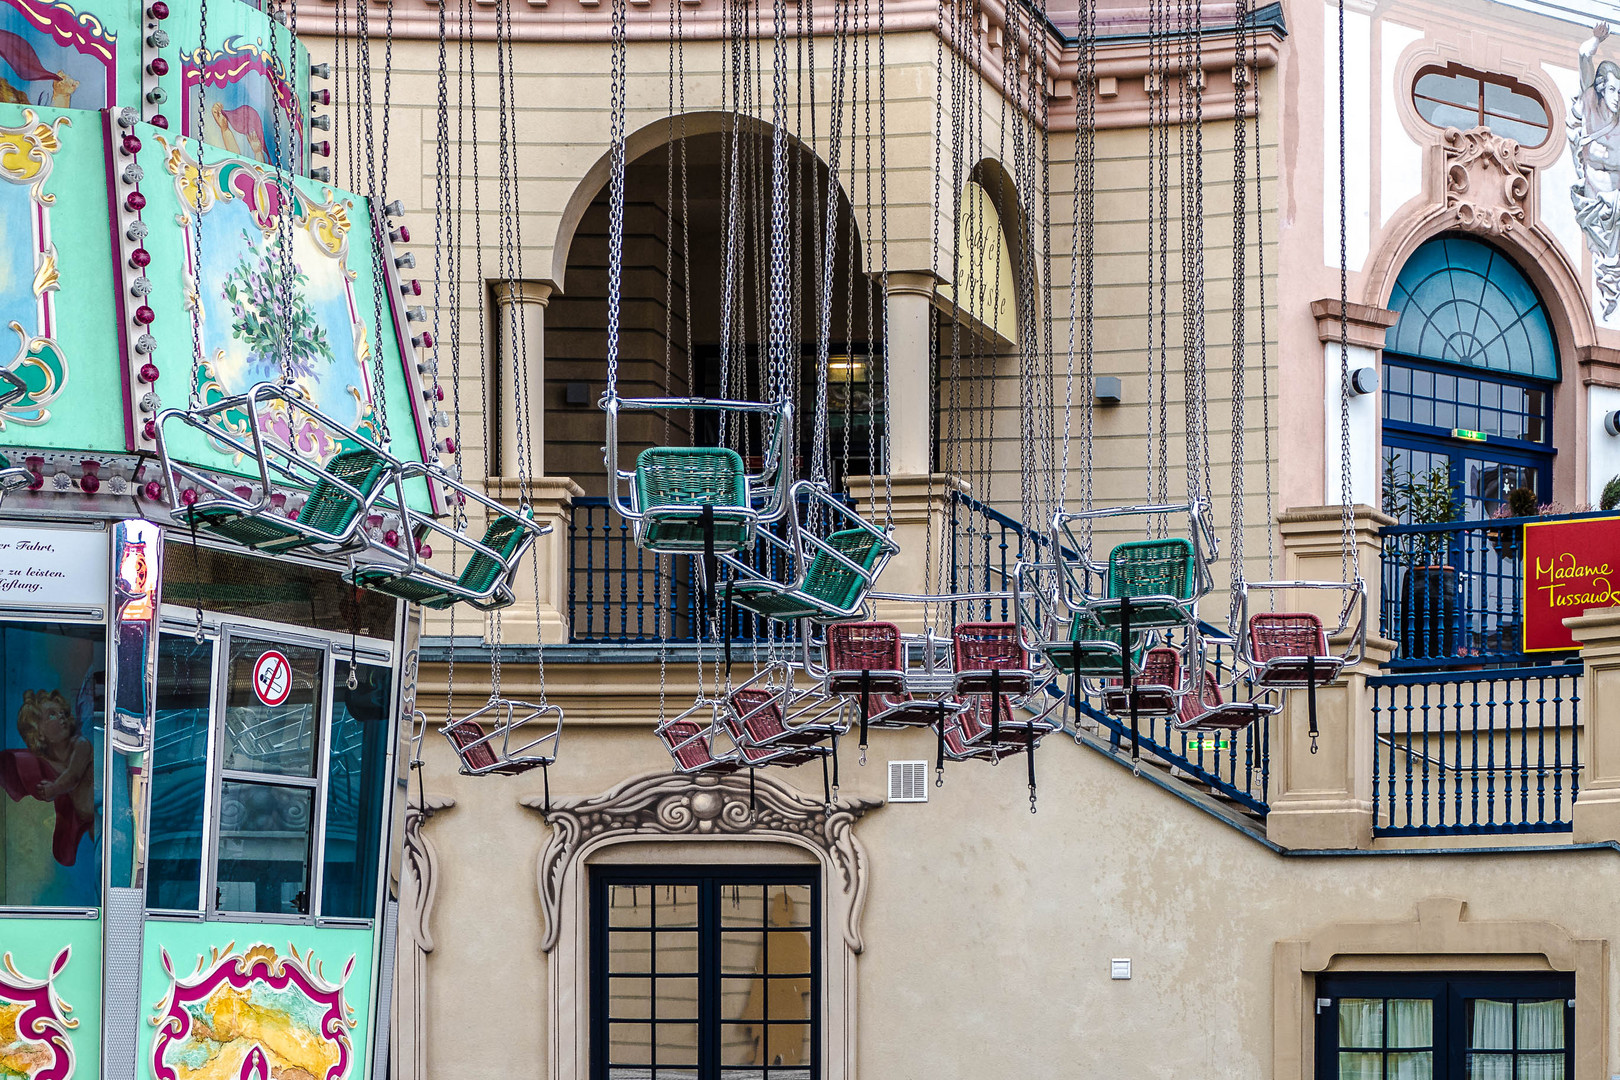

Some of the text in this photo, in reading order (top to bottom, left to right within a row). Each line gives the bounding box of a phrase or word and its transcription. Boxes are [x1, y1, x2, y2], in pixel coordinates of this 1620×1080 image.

[16, 540, 55, 553] Fahrt,
[26, 567, 66, 578] leisten.
[1536, 552, 1614, 583] Madame
